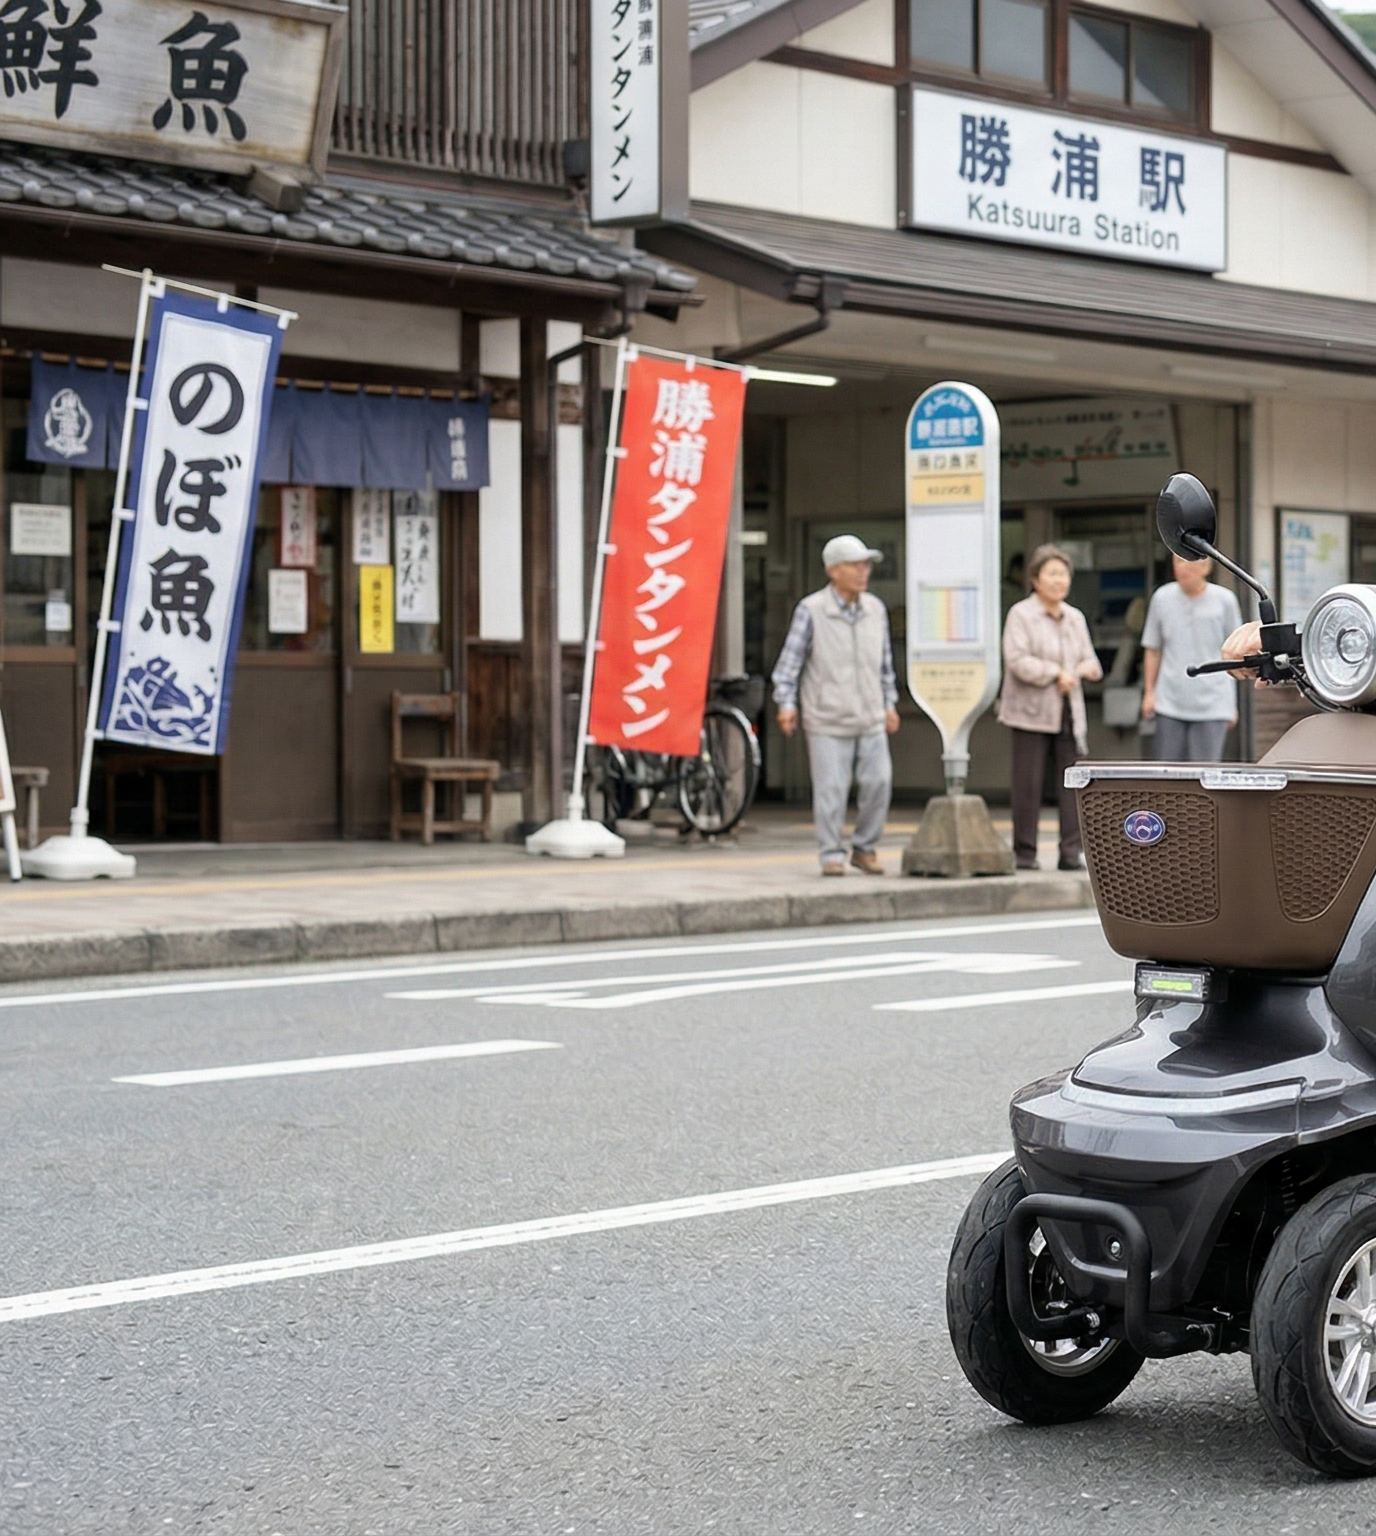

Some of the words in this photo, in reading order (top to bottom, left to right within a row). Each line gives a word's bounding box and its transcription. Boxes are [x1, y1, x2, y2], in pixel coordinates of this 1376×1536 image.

[0, 0, 249, 141] 鮮魚
[610, 0, 634, 203] タンタンメン
[958, 113, 1187, 216] 勝浦駅
[967, 193, 1082, 237] Katsuura
[1094, 213, 1180, 252] Station
[138, 362, 245, 643] のぼ魚
[620, 377, 716, 739] 勝浦タンタンメン
